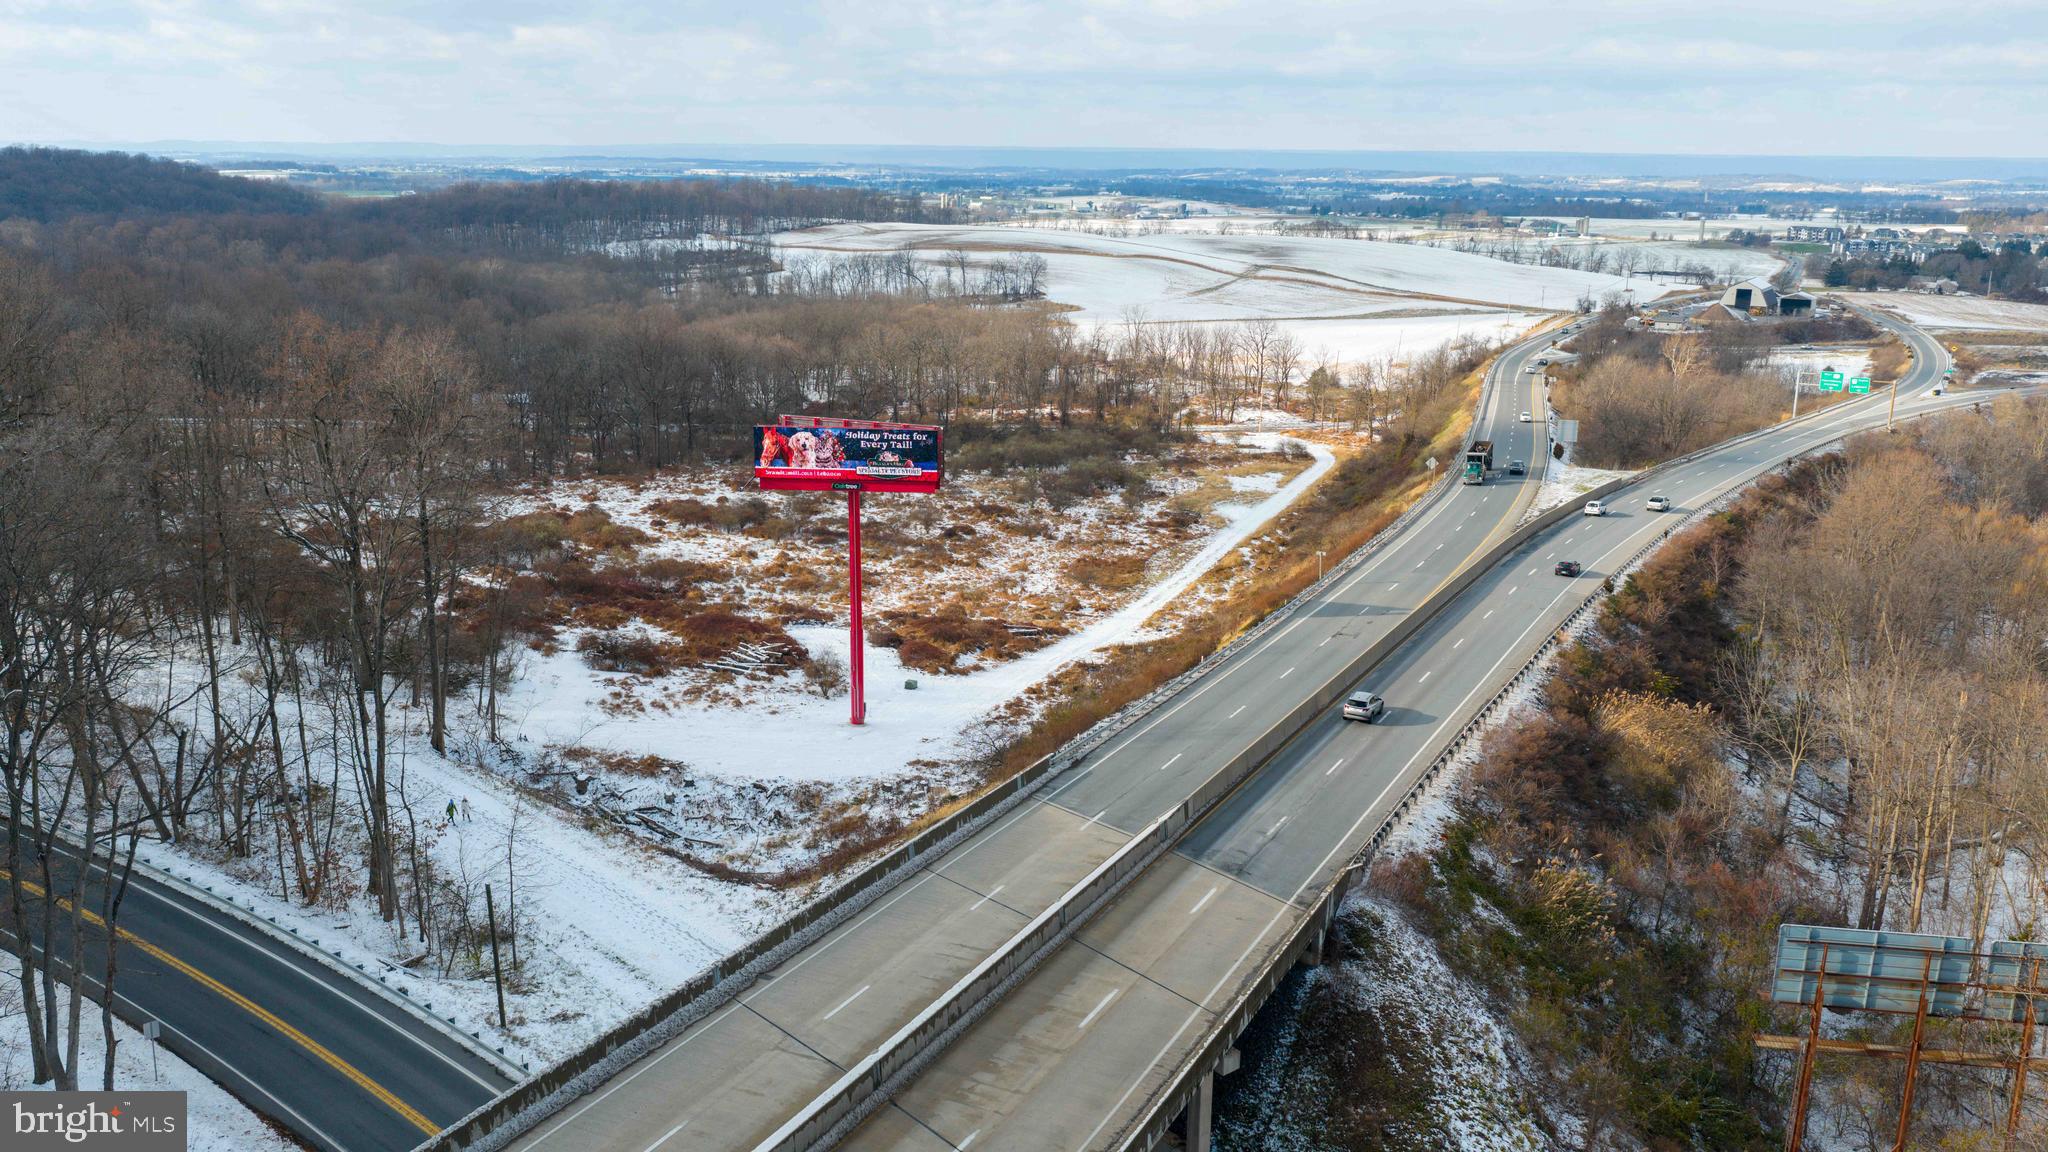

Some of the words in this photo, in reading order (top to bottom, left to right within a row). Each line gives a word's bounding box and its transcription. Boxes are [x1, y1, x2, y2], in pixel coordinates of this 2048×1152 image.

[845, 431, 880, 441] Holiday
[883, 432, 910, 440] Treats
[860, 441, 887, 450] Every
[890, 441, 912, 449] Tail!
